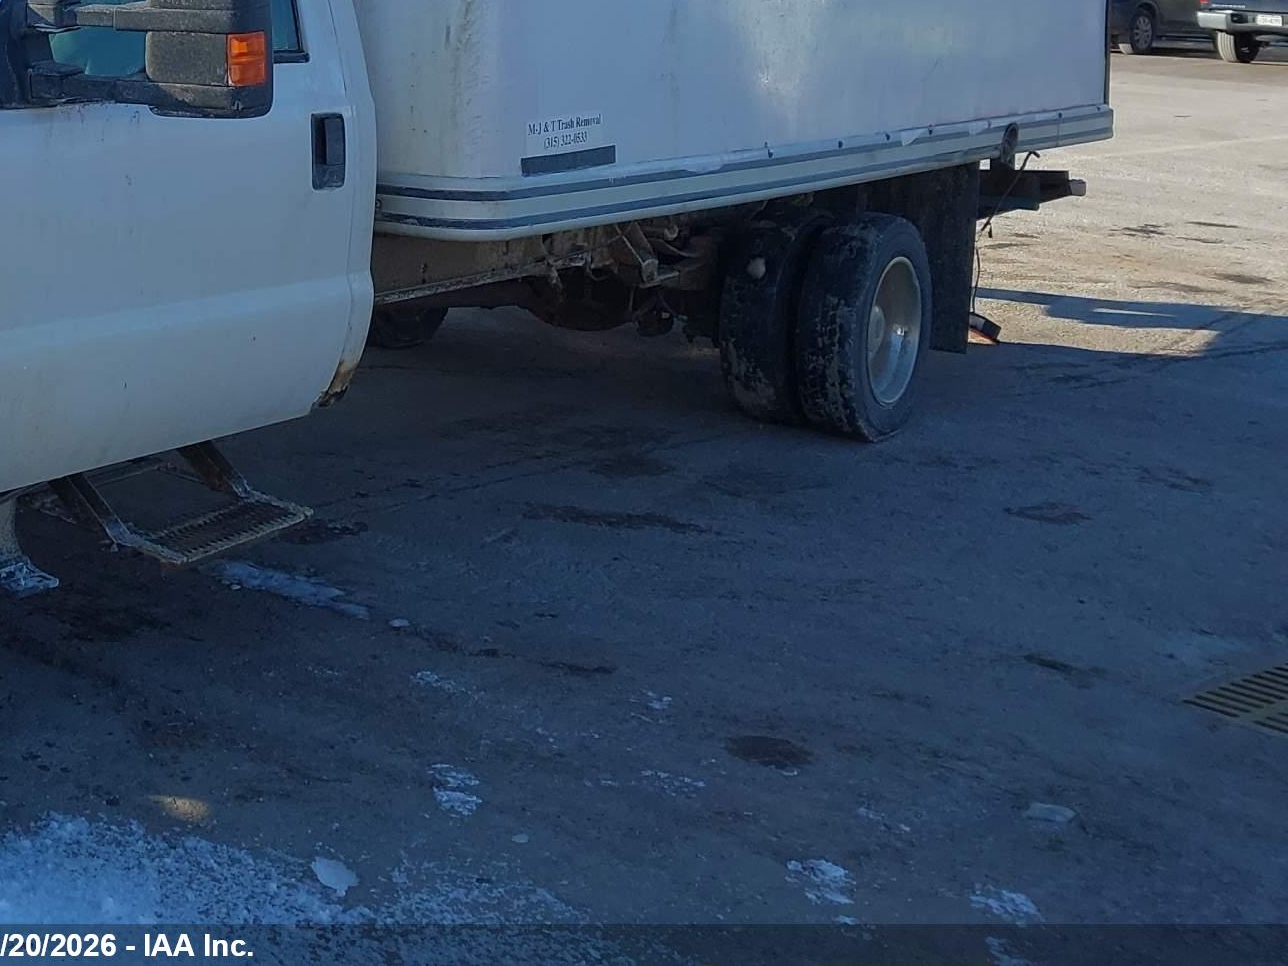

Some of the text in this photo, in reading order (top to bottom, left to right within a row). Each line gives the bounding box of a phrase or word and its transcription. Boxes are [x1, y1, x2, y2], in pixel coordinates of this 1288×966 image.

[543, 121, 550, 133] &
[551, 120, 557, 132] T
[557, 117, 575, 131] Trash
[575, 113, 601, 127] Removal
